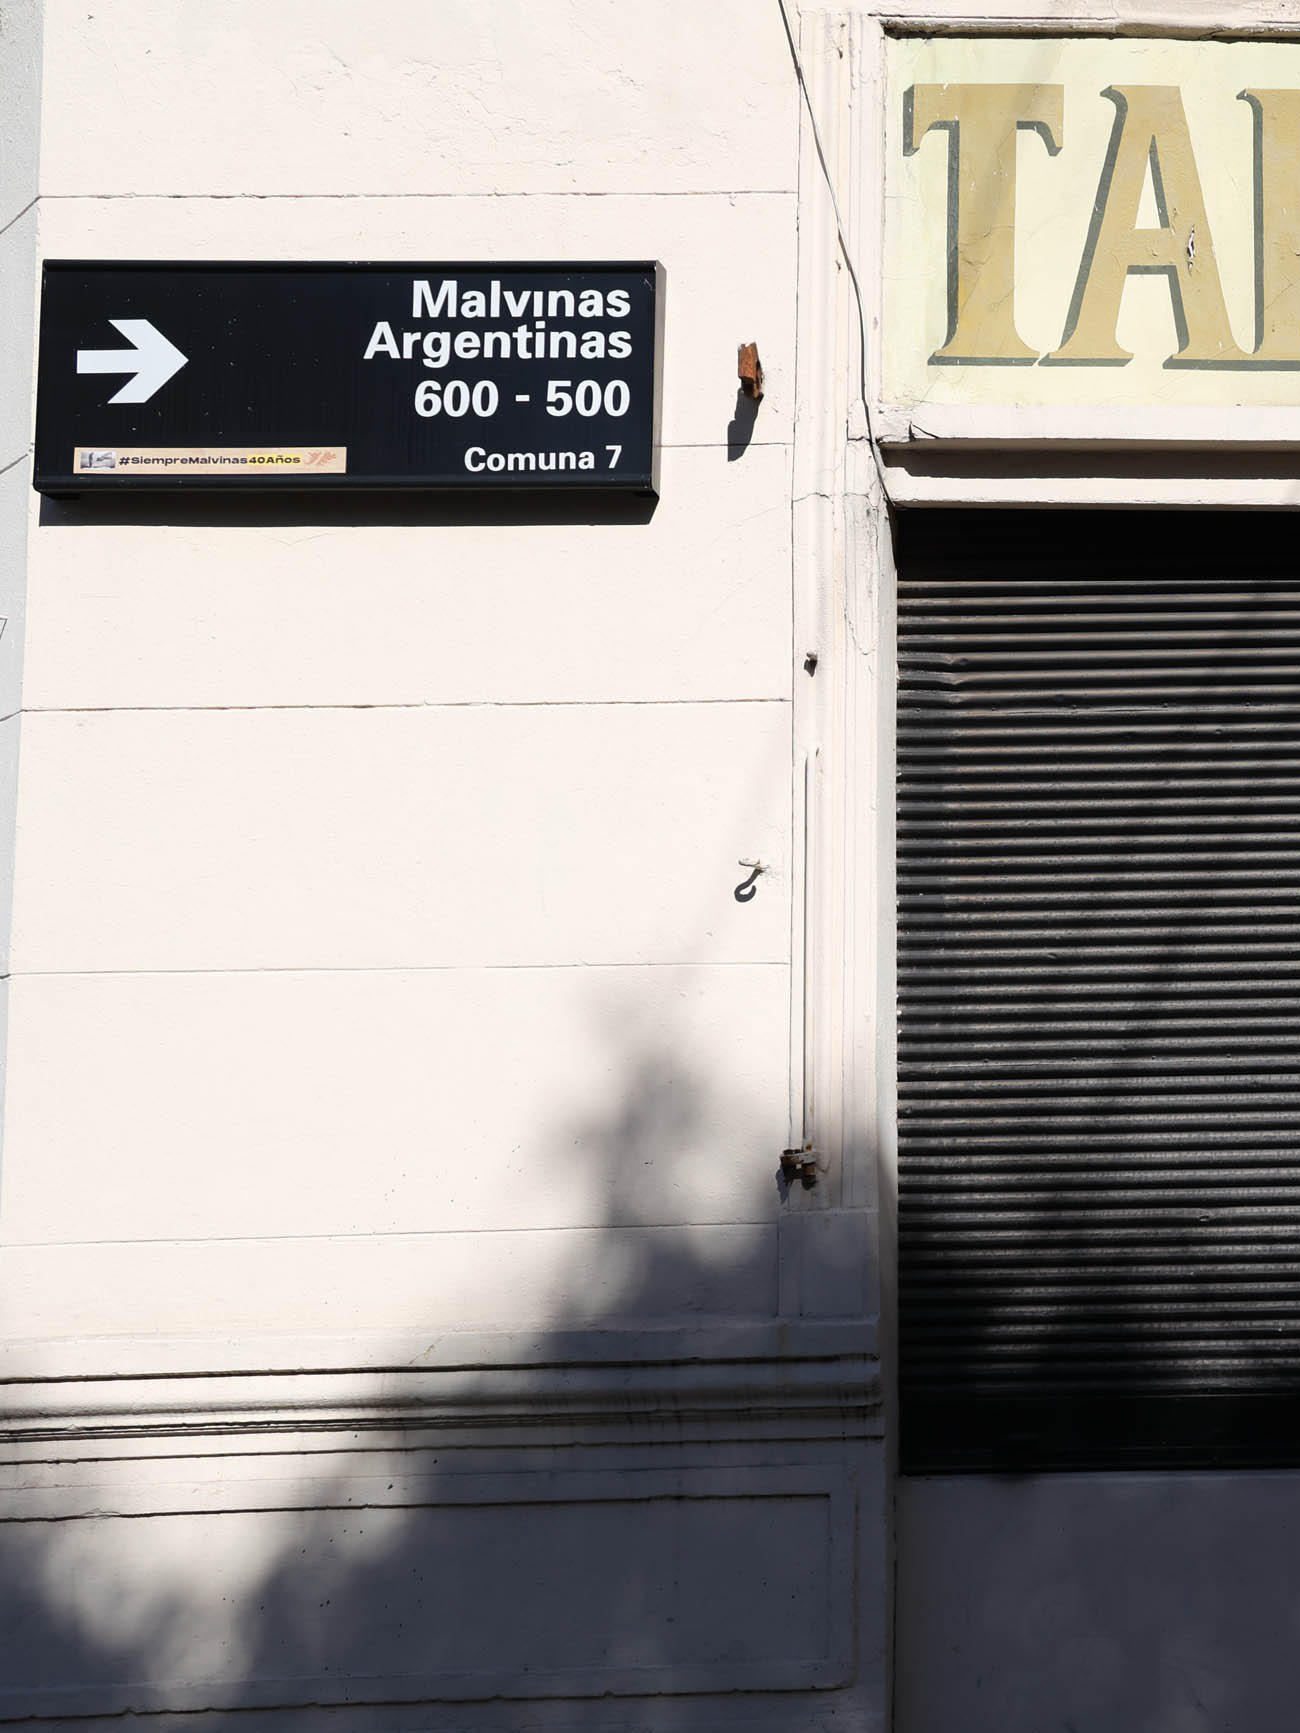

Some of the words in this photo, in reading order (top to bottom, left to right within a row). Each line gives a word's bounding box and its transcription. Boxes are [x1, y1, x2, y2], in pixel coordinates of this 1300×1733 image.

[412, 280, 631, 318] Malvinas
[363, 320, 633, 368] Argentinas
[414, 380, 499, 417] 600
[515, 394, 530, 402] -
[545, 379, 631, 417] 500
[464, 446, 595, 472] Comuna
[605, 445, 622, 469] 7
